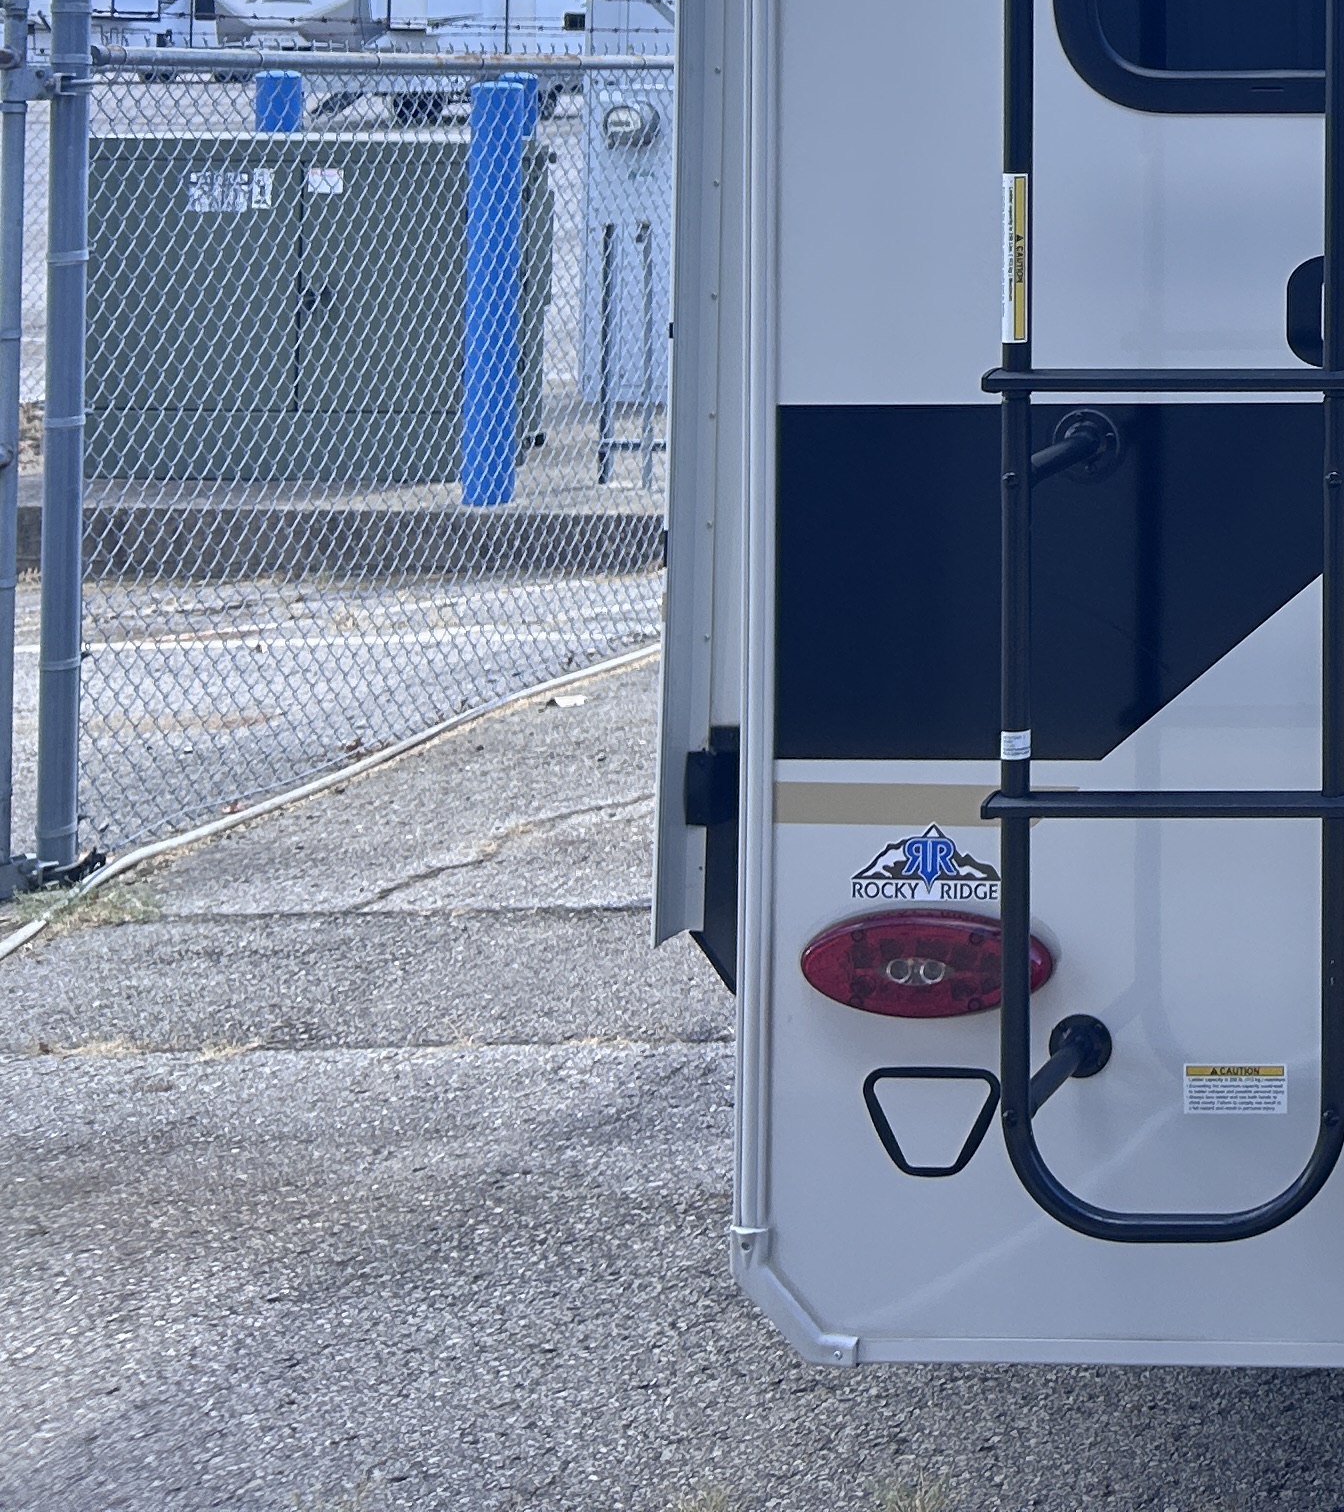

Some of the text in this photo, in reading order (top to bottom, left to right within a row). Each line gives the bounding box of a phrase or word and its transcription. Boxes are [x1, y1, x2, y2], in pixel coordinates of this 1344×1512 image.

[1016, 245, 1024, 283] CAUTION
[852, 882, 998, 900] ROCKY RIDGE
[1220, 1067, 1260, 1076] CAUTION
